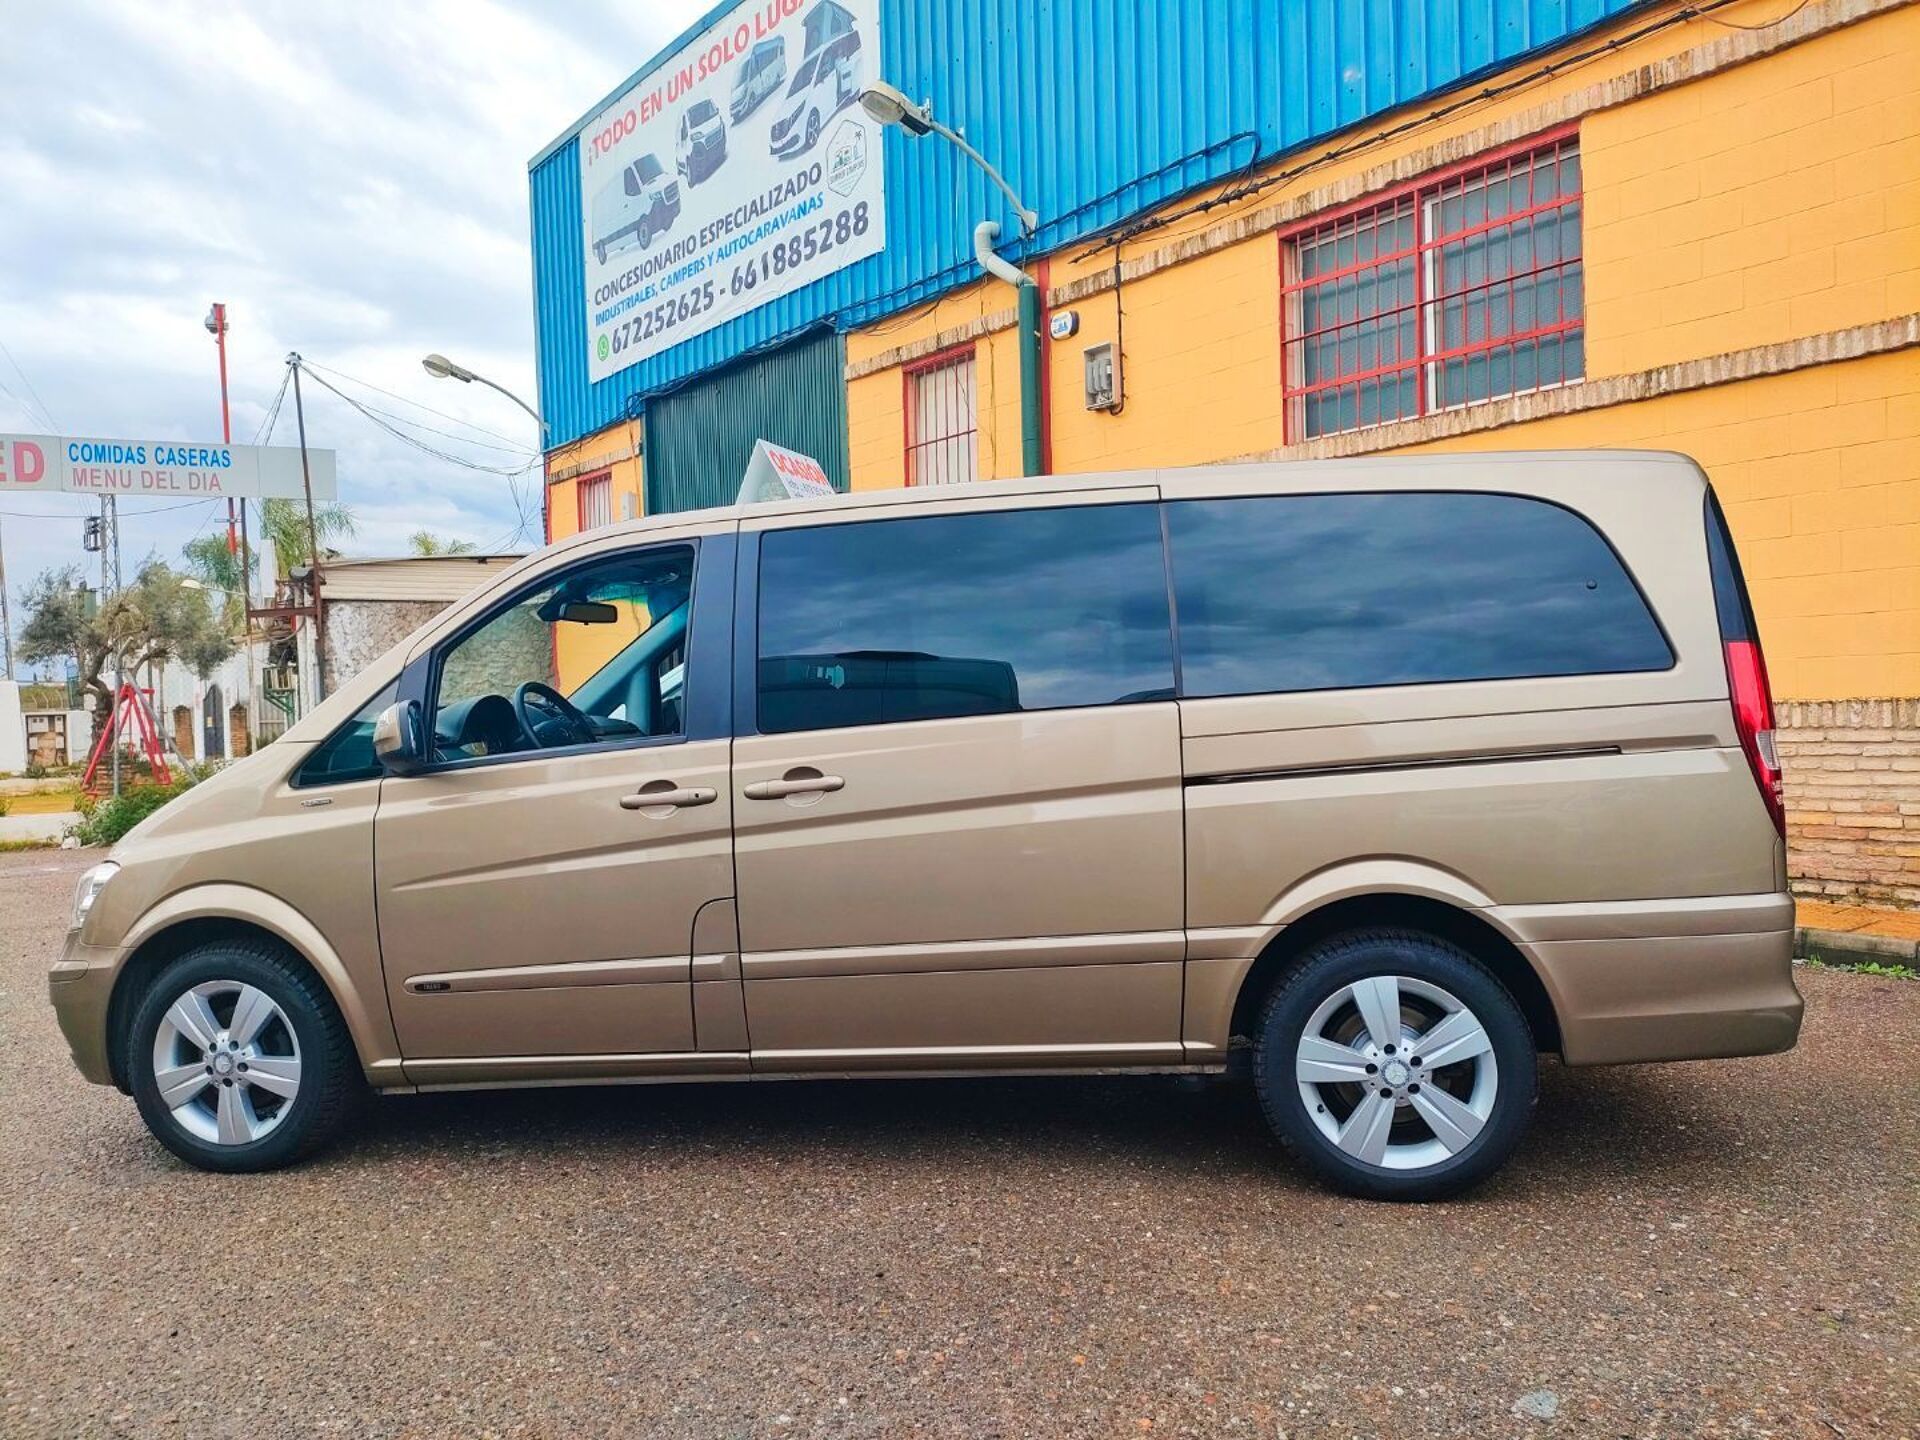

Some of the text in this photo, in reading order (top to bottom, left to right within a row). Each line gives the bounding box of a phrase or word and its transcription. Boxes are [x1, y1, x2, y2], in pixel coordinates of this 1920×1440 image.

[588, 0, 803, 167] ¡TODO EN UN SOLO LUG
[595, 235, 697, 306] CONCESIONARIO
[700, 162, 822, 248] ESPECIALIZADO
[595, 191, 824, 327] INDUSTRIALES, CAMPERS Y AUTOCARAVANAS
[612, 280, 715, 354] 672252625
[731, 201, 869, 296] 661885288
[68, 443, 231, 468] COMIDAS CASERAS
[72, 467, 222, 491] MENU DEL DIA
